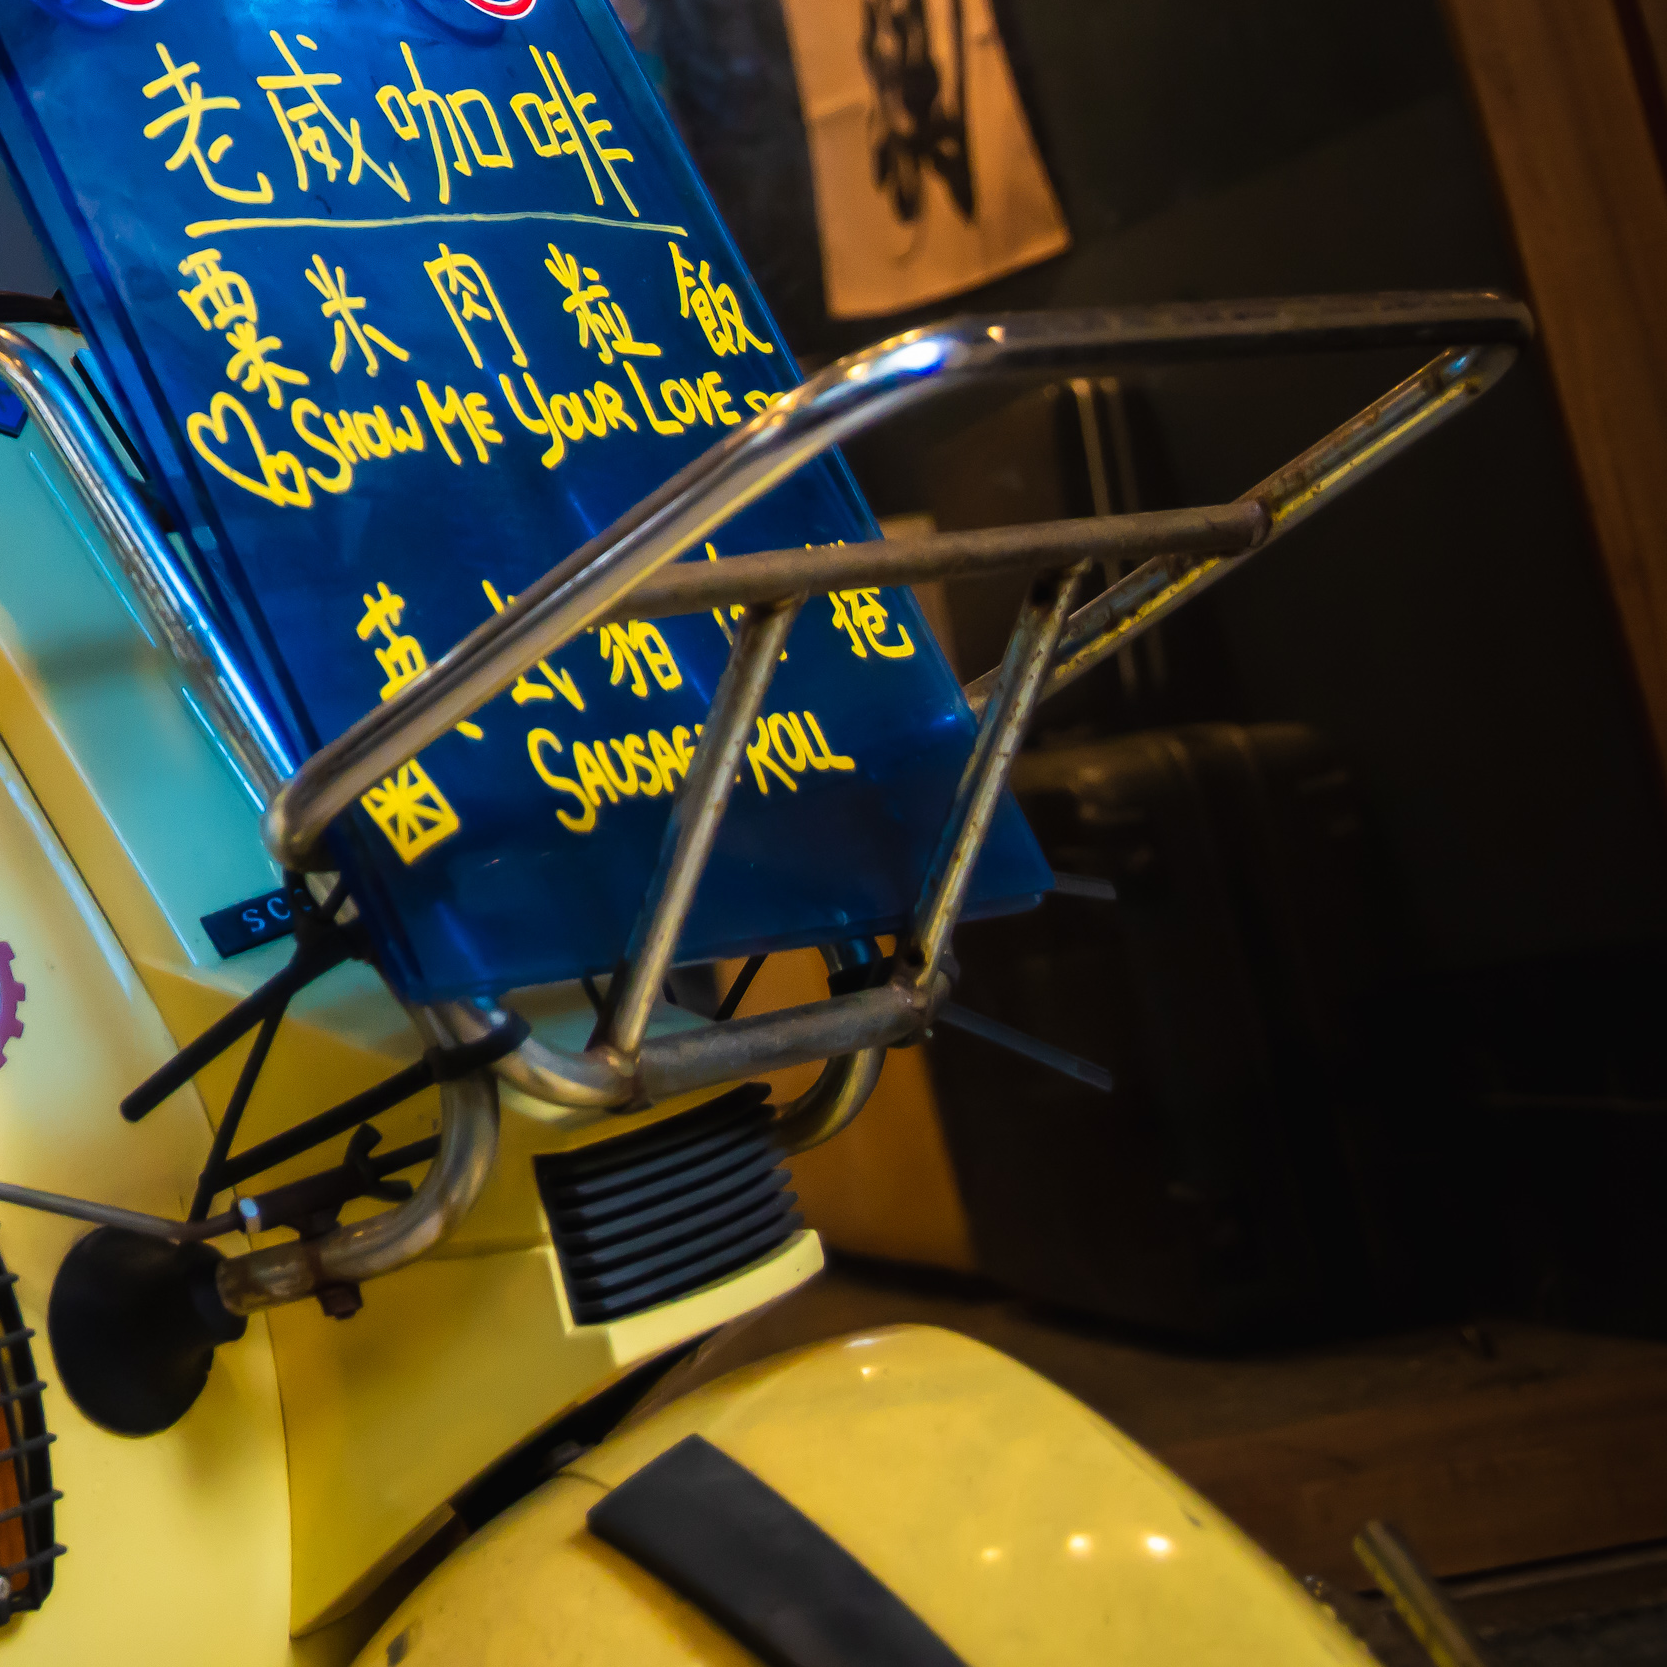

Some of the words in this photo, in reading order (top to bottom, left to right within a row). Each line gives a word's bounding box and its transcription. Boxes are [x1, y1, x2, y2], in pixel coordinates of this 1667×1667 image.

[142, 29, 639, 217] 老威咖啡
[527, 723, 741, 833] SAUSAG
